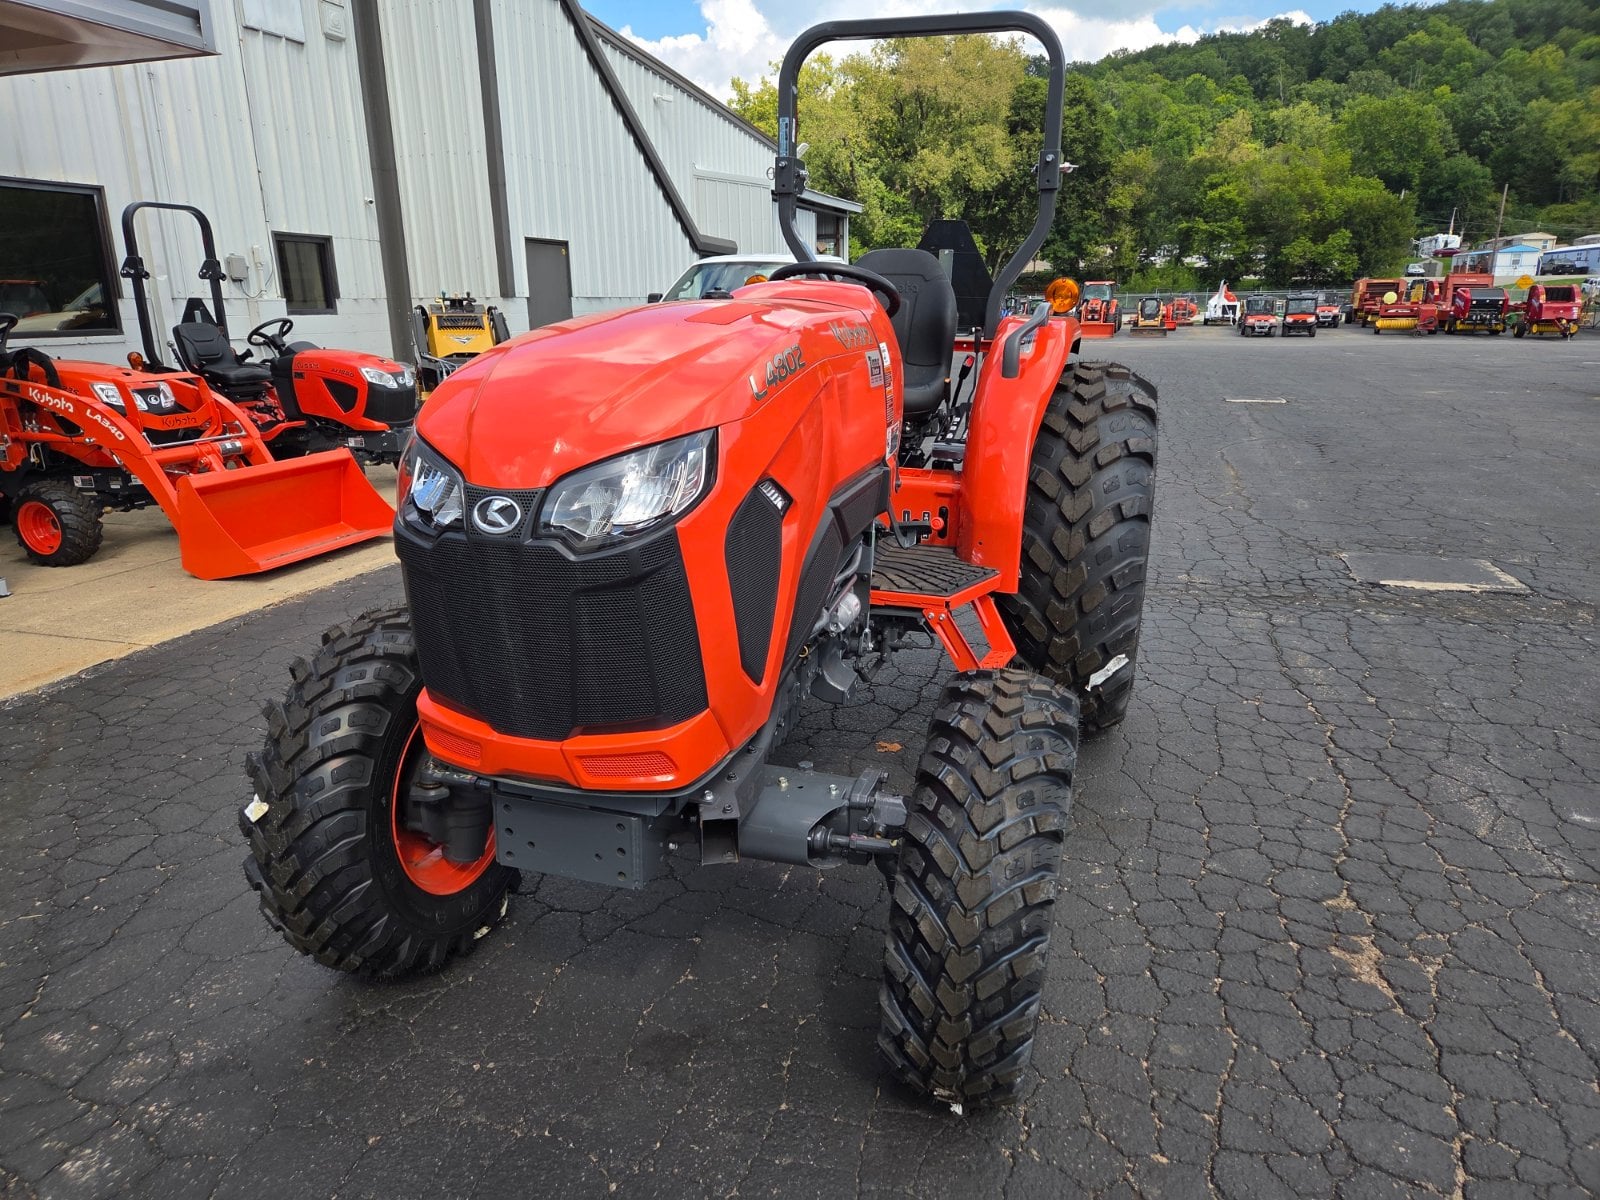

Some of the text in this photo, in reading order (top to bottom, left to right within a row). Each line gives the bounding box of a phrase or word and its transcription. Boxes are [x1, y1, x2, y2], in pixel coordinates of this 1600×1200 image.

[748, 343, 806, 401] L4802
[28, 387, 74, 413] Kubota
[85, 409, 125, 441] LA340
[161, 415, 198, 428] Kubota
